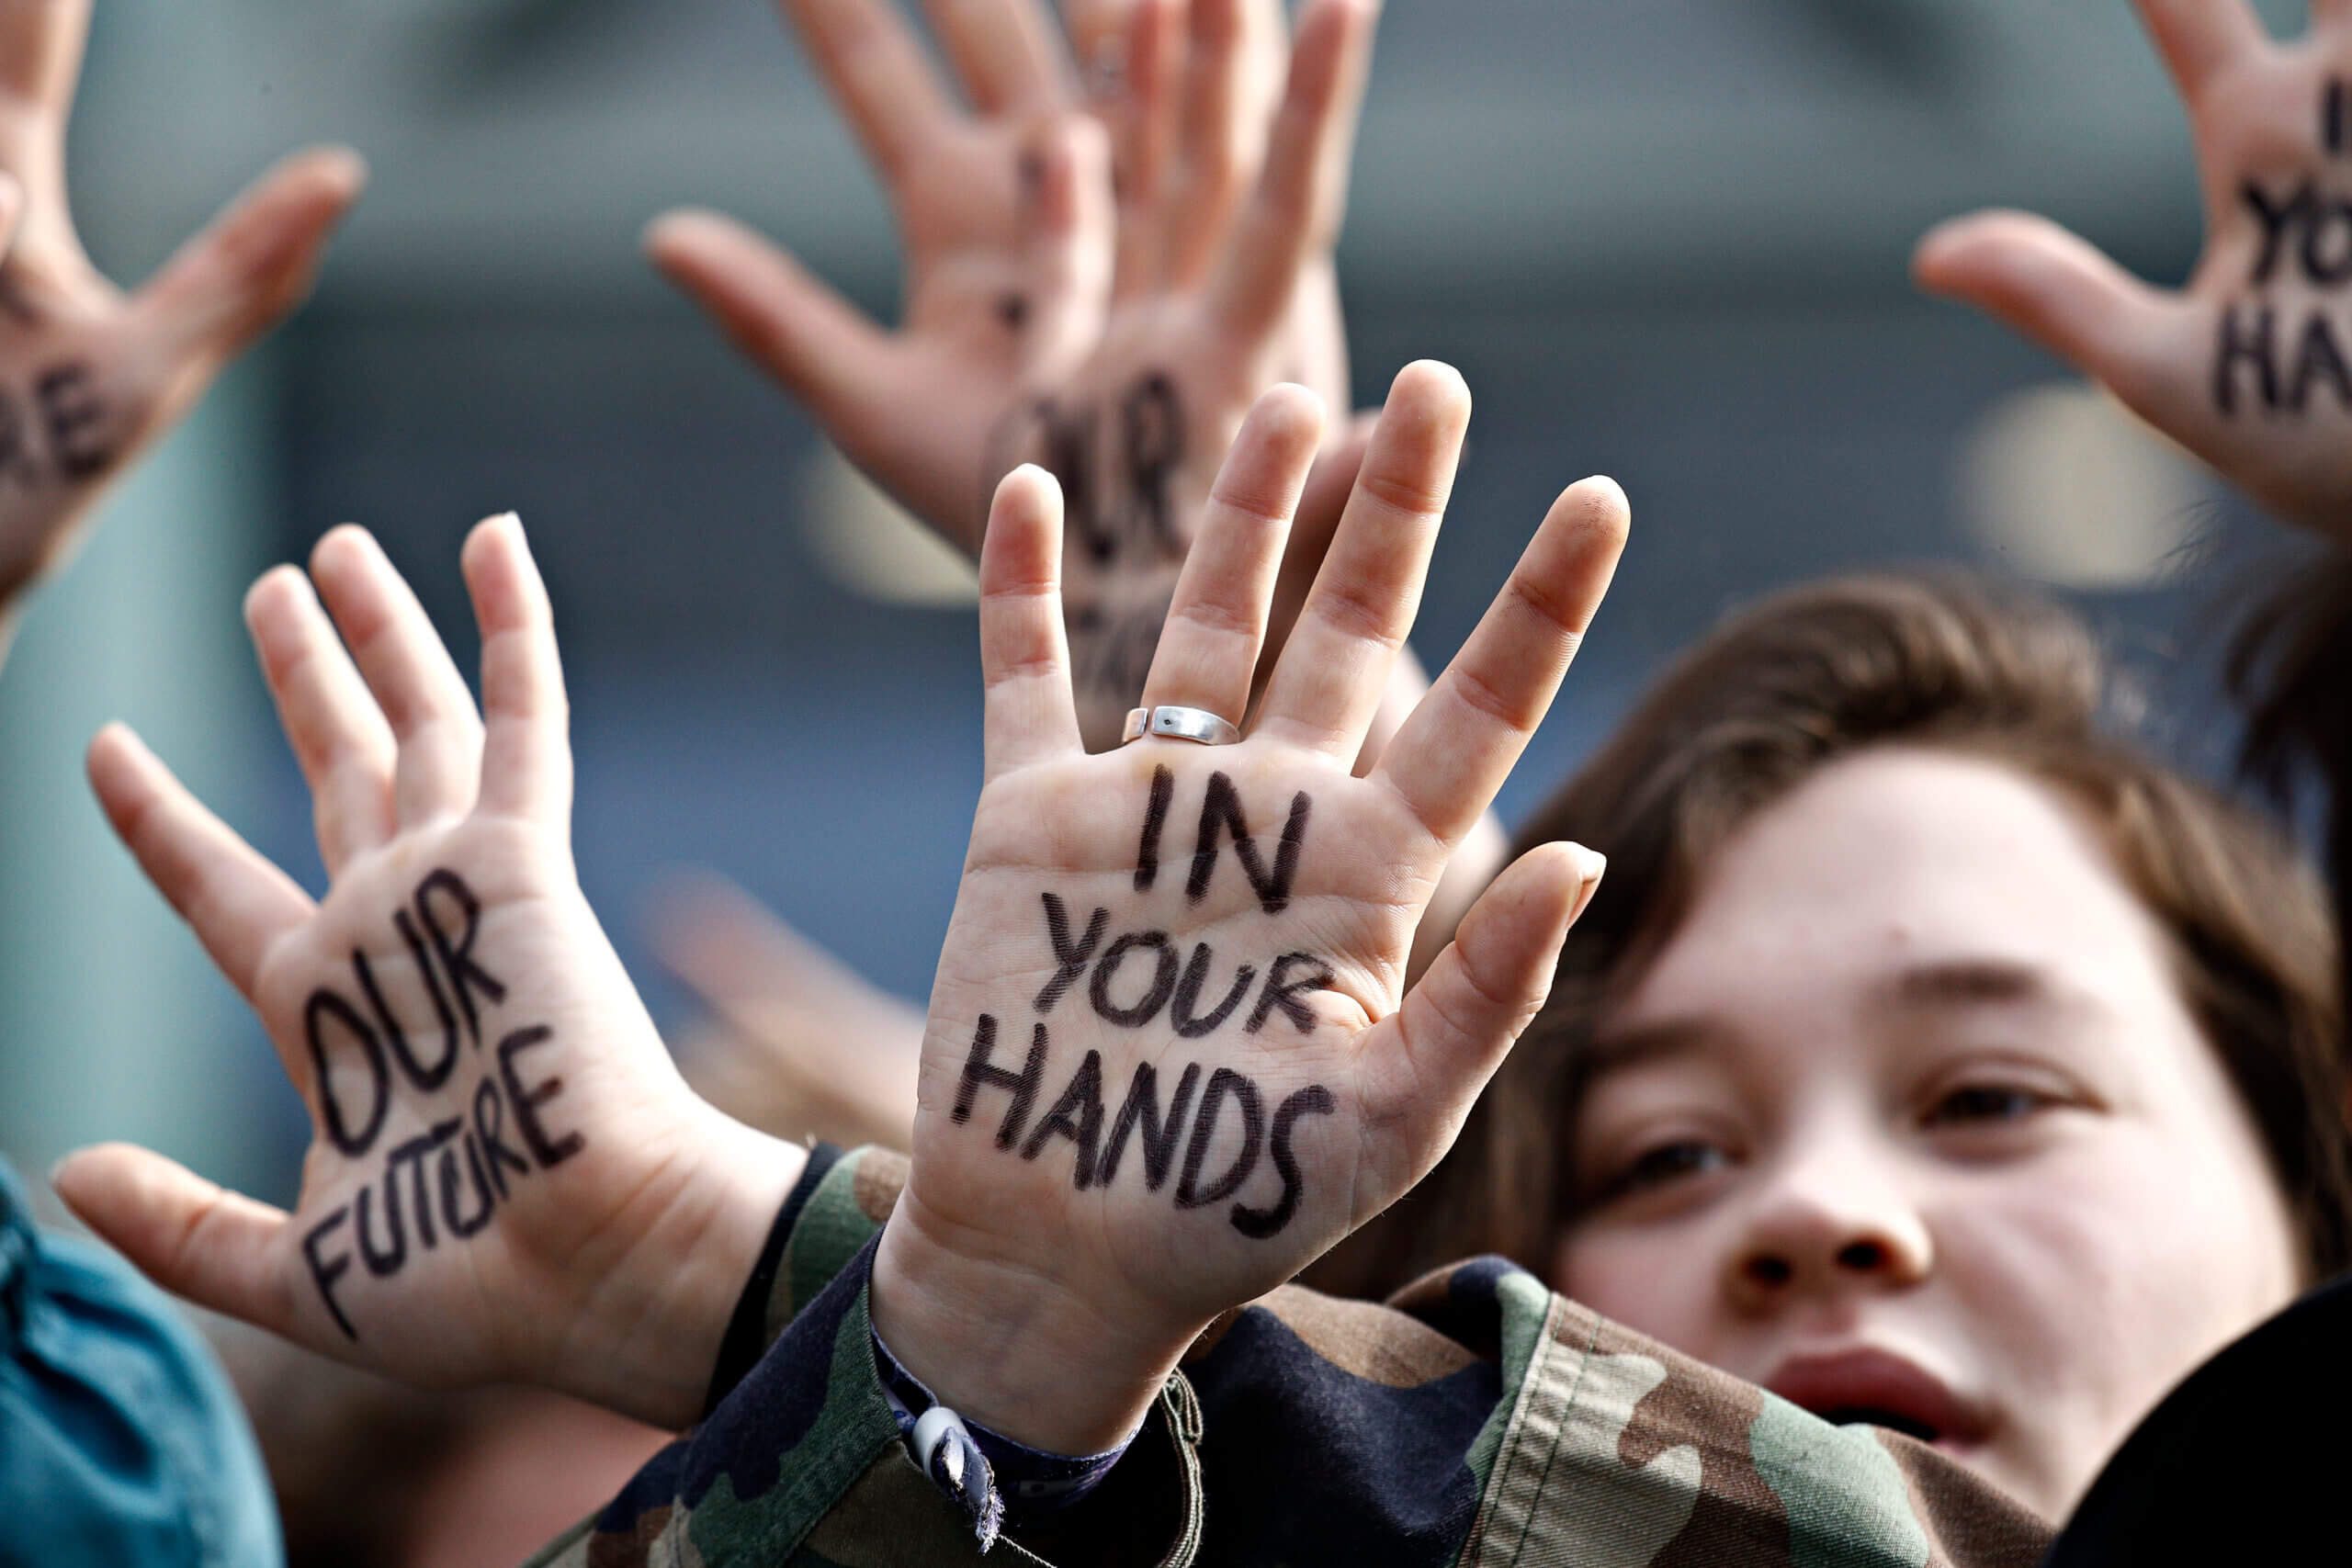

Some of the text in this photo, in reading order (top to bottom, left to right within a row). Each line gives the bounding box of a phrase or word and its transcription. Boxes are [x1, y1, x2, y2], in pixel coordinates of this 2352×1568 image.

[2236, 176, 2352, 292] YO
[2212, 303, 2352, 417] HA
[1134, 763, 1313, 914] IN
[304, 867, 507, 1159] OUR
[1033, 892, 1336, 1038] YOUR
[302, 1023, 586, 1342] FUTURE
[950, 1013, 1339, 1239] HANDS
